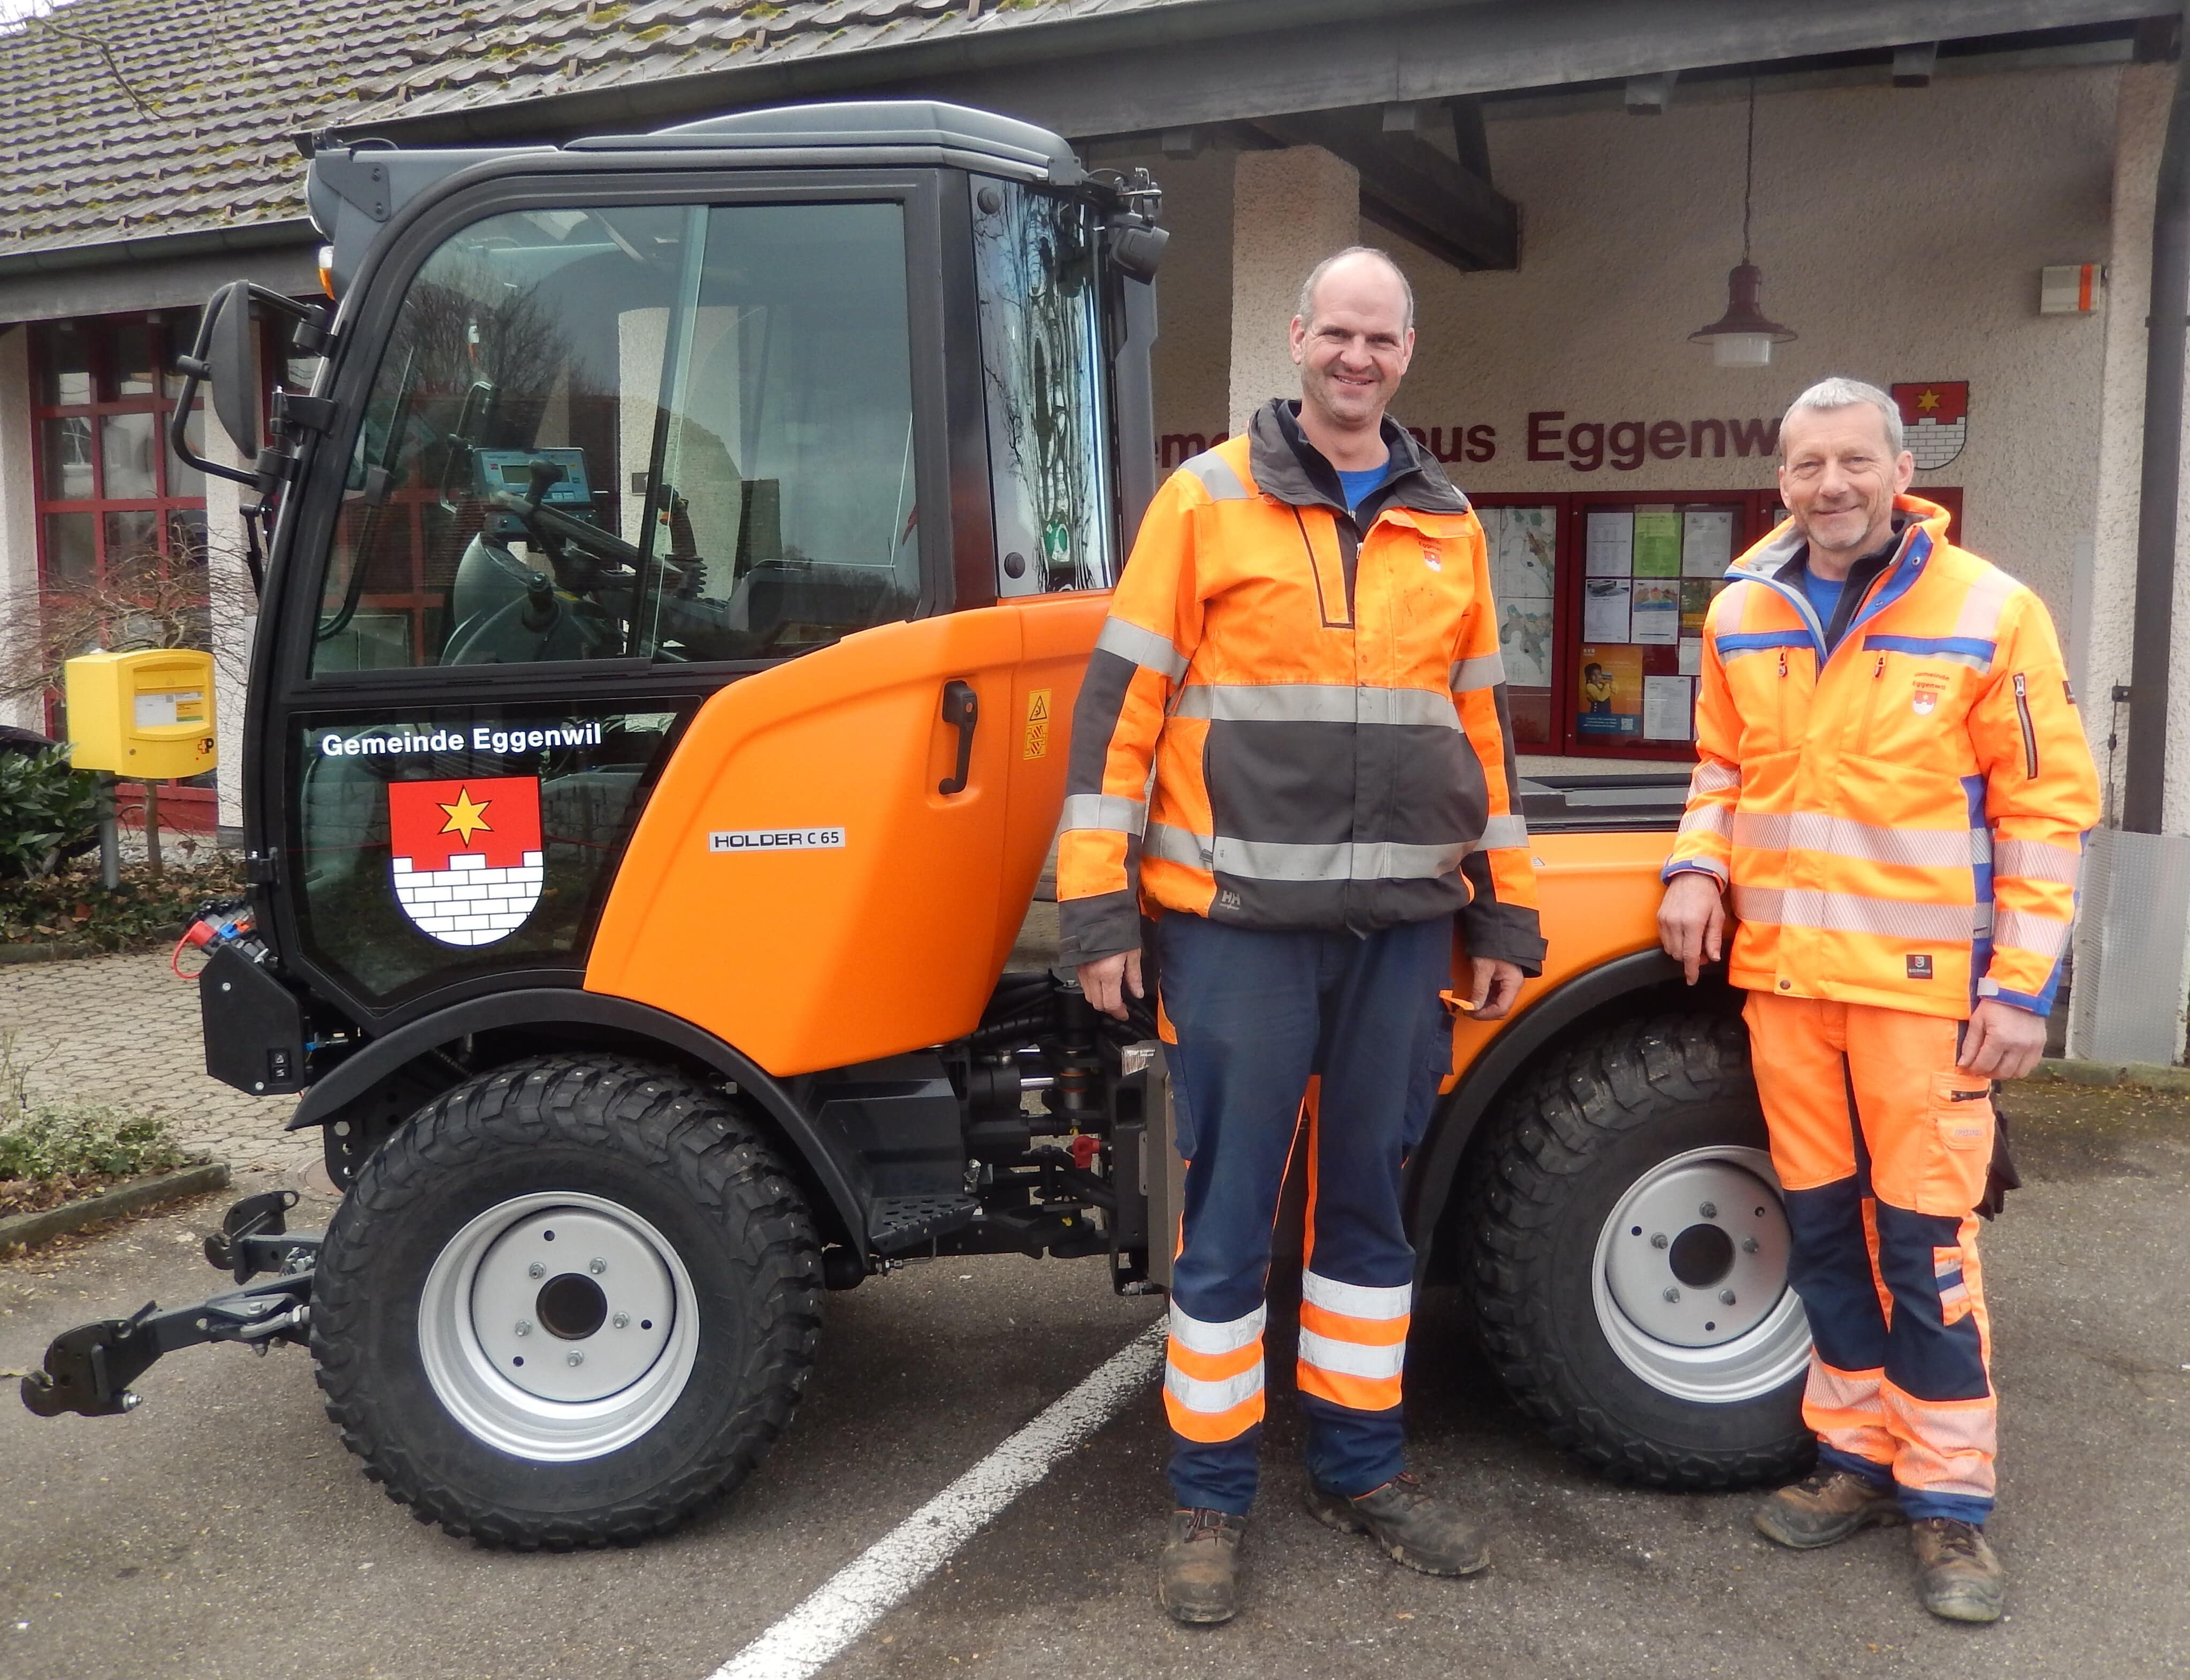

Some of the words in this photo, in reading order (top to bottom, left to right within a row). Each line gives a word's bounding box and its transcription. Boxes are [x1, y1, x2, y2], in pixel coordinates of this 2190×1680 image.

[1407, 425, 1496, 464] us
[321, 730, 465, 756] Gemeinde
[473, 724, 602, 753] Eggenwil
[715, 833, 802, 848] HOLDER
[808, 832, 816, 844] C
[821, 832, 839, 843] 65
[1221, 890, 1241, 905] HH
